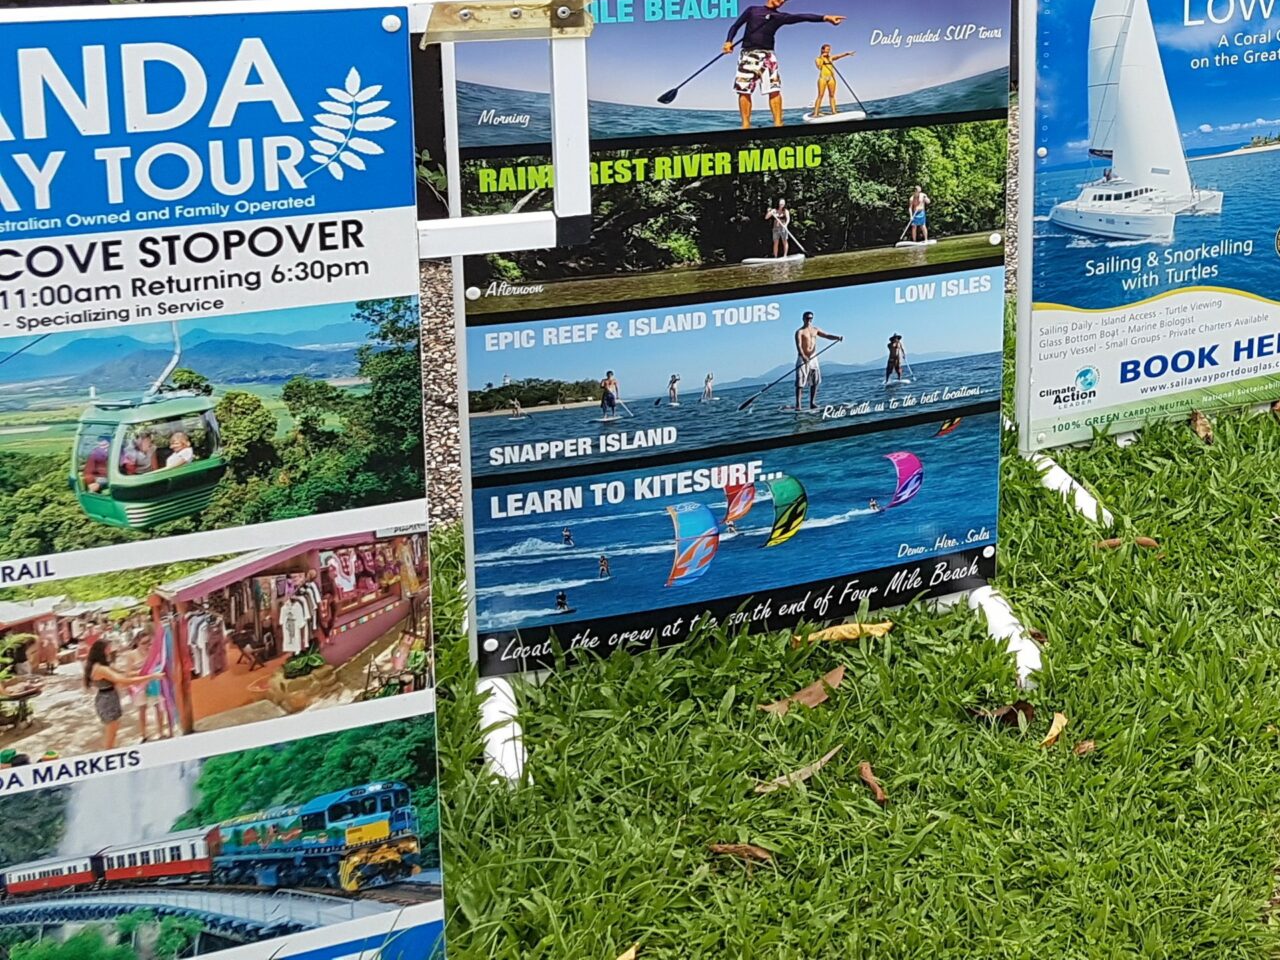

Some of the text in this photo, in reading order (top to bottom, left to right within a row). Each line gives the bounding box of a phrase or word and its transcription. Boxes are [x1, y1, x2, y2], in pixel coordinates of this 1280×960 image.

[870, 24, 1001, 47] Daily guided SUP tours
[1217, 34, 1230, 48] A
[1234, 28, 1270, 46] Coral
[1190, 58, 1210, 70] on
[1214, 53, 1239, 67] the
[0, 38, 304, 140] NDA
[478, 109, 530, 128] Morning
[95, 135, 306, 203] TOUR
[654, 144, 822, 180] RIVER MAGIC
[0, 195, 315, 233] stralian Owned and Family Operated
[139, 219, 364, 268] STOPOVER
[1085, 239, 1253, 278] Sailing & Snorkelling
[132, 269, 262, 298] Returning
[272, 258, 370, 283] 6:30pm
[485, 281, 544, 298] Afternoon
[895, 275, 991, 304] LOW ISLES
[1122, 264, 1218, 291] with Turtles
[16, 297, 224, 331] Specializing in Service
[485, 302, 781, 351] EPIC REEF & ISLAND TOURS
[1040, 300, 1222, 336] Sailing Daily Island Access Turtle Viewing
[1119, 344, 1219, 385] BOOK
[822, 405, 847, 420] Ride
[850, 402, 870, 416] with
[875, 402, 885, 412] us
[889, 399, 898, 409] to
[902, 396, 917, 407] the
[921, 392, 938, 405] best
[1040, 386, 1076, 397] Climate
[1053, 390, 1096, 405] Action
[1059, 400, 1091, 409] LEADER
[1052, 399, 1194, 433] 100% GREEN CARBON NEUTRAL
[489, 426, 677, 466] SNAPPER ISLAND
[490, 459, 784, 519] LEARN TO KITESURF...
[1, 560, 55, 583] RAIL
[571, 556, 978, 648] the crew at end of Four Mile Beach
[32, 750, 140, 784] MARKETS
